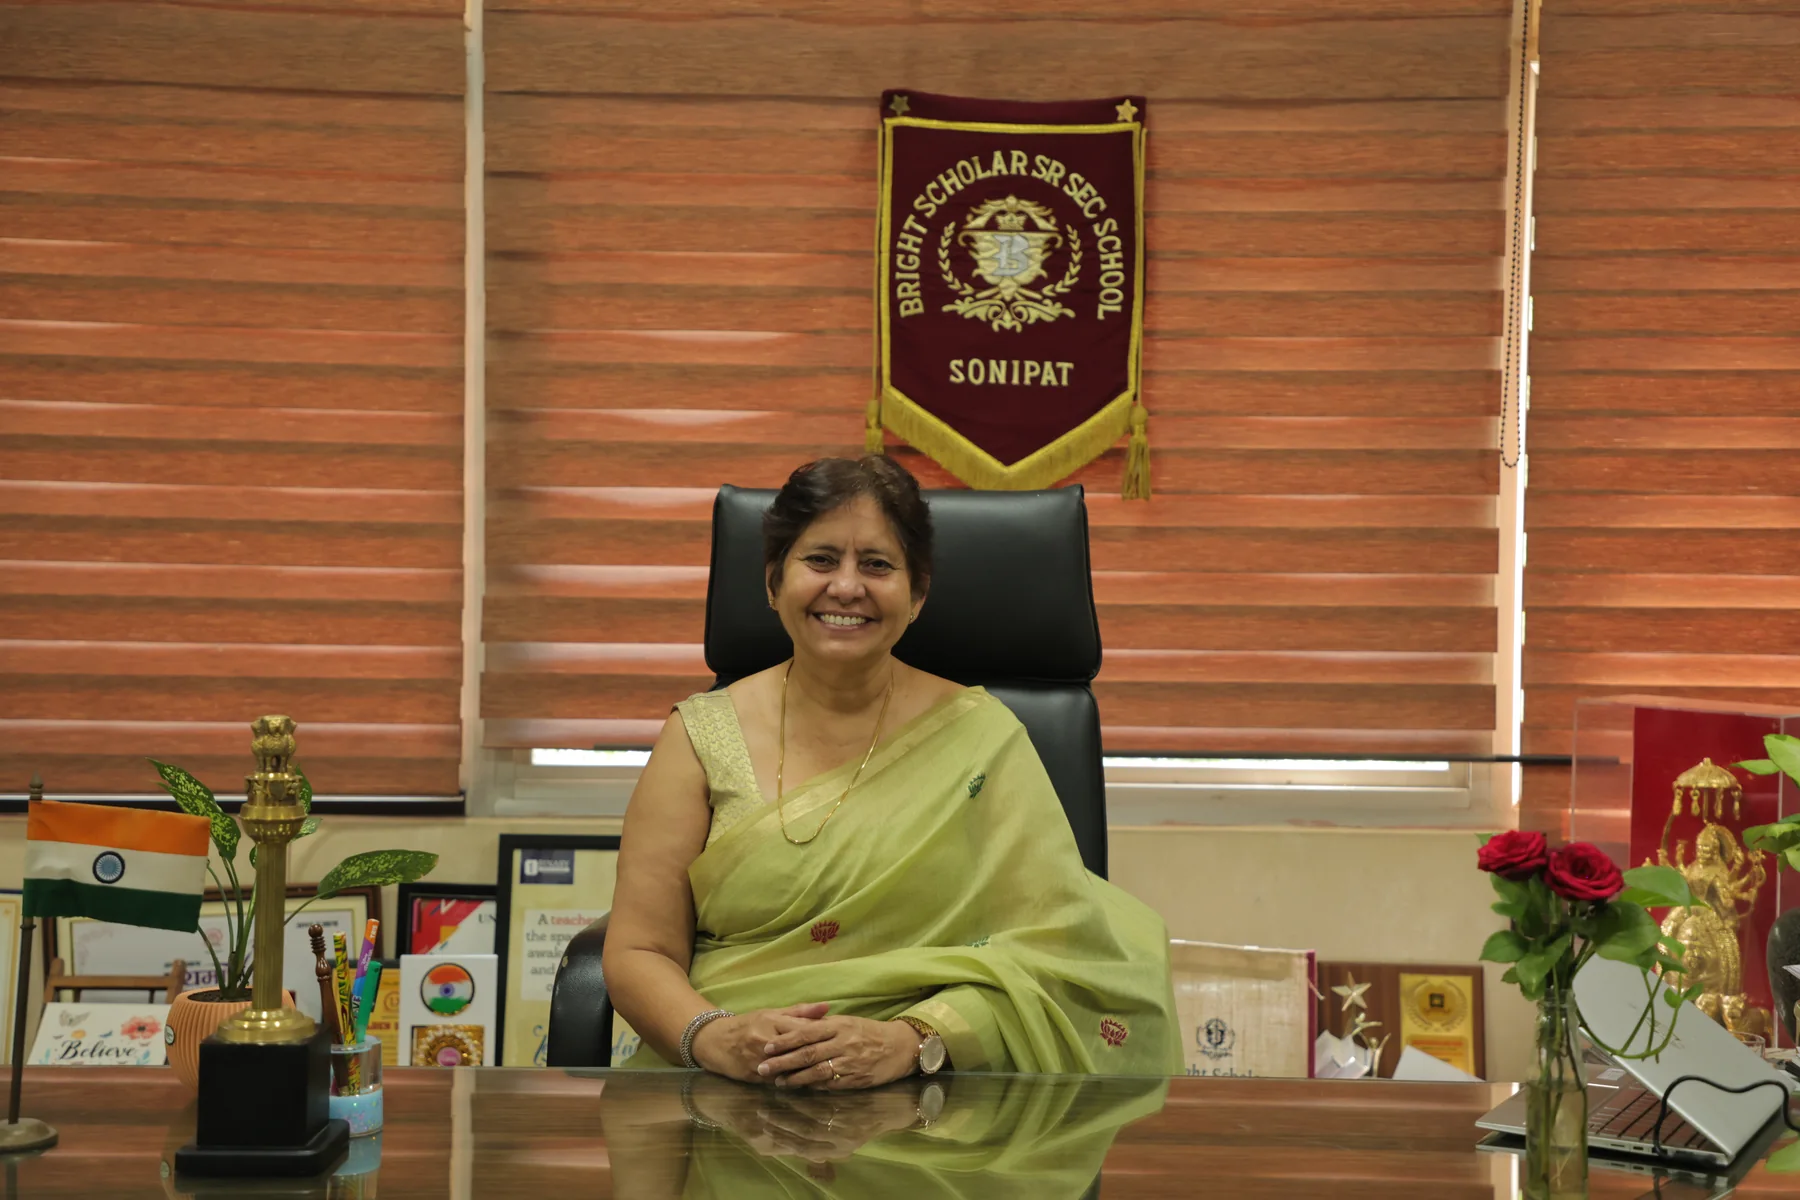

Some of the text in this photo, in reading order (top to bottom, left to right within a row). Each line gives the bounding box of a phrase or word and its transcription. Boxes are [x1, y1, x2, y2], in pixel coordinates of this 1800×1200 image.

[895, 150, 1125, 320] BRIGHT SCHOLAR SR SEC SCHOOL
[949, 358, 1075, 386] SONIPAT
[538, 913, 548, 925] A
[526, 930, 573, 946] the spa
[530, 963, 556, 975] and
[60, 1040, 136, 1060] Believe
